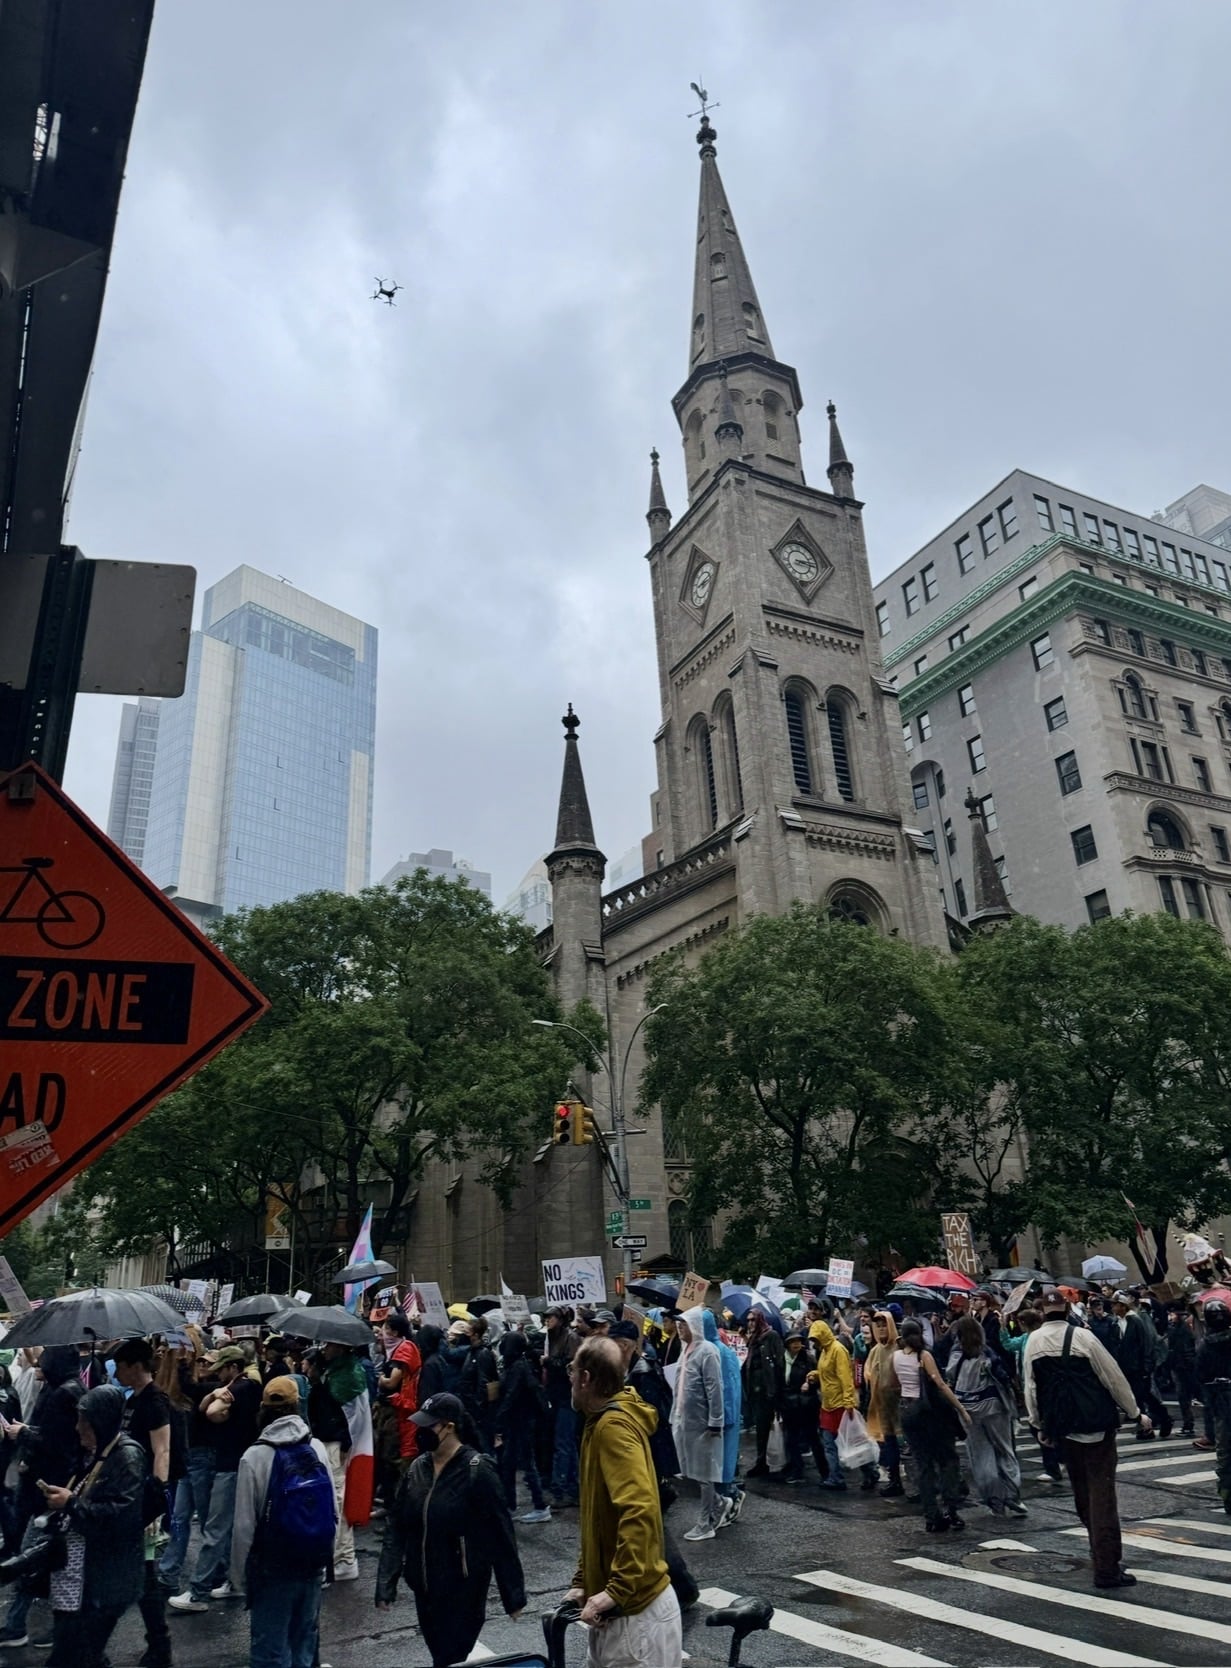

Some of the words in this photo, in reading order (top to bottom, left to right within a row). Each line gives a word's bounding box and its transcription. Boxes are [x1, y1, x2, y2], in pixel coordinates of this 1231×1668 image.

[7, 970, 148, 1030] ZONE
[942, 1215, 969, 1232] TAX
[944, 1232, 969, 1248] THE
[946, 1248, 978, 1274] RICH
[543, 1264, 562, 1282] NO
[684, 1277, 698, 1289] NY
[547, 1282, 585, 1302] KINGS
[682, 1288, 695, 1301] LA
